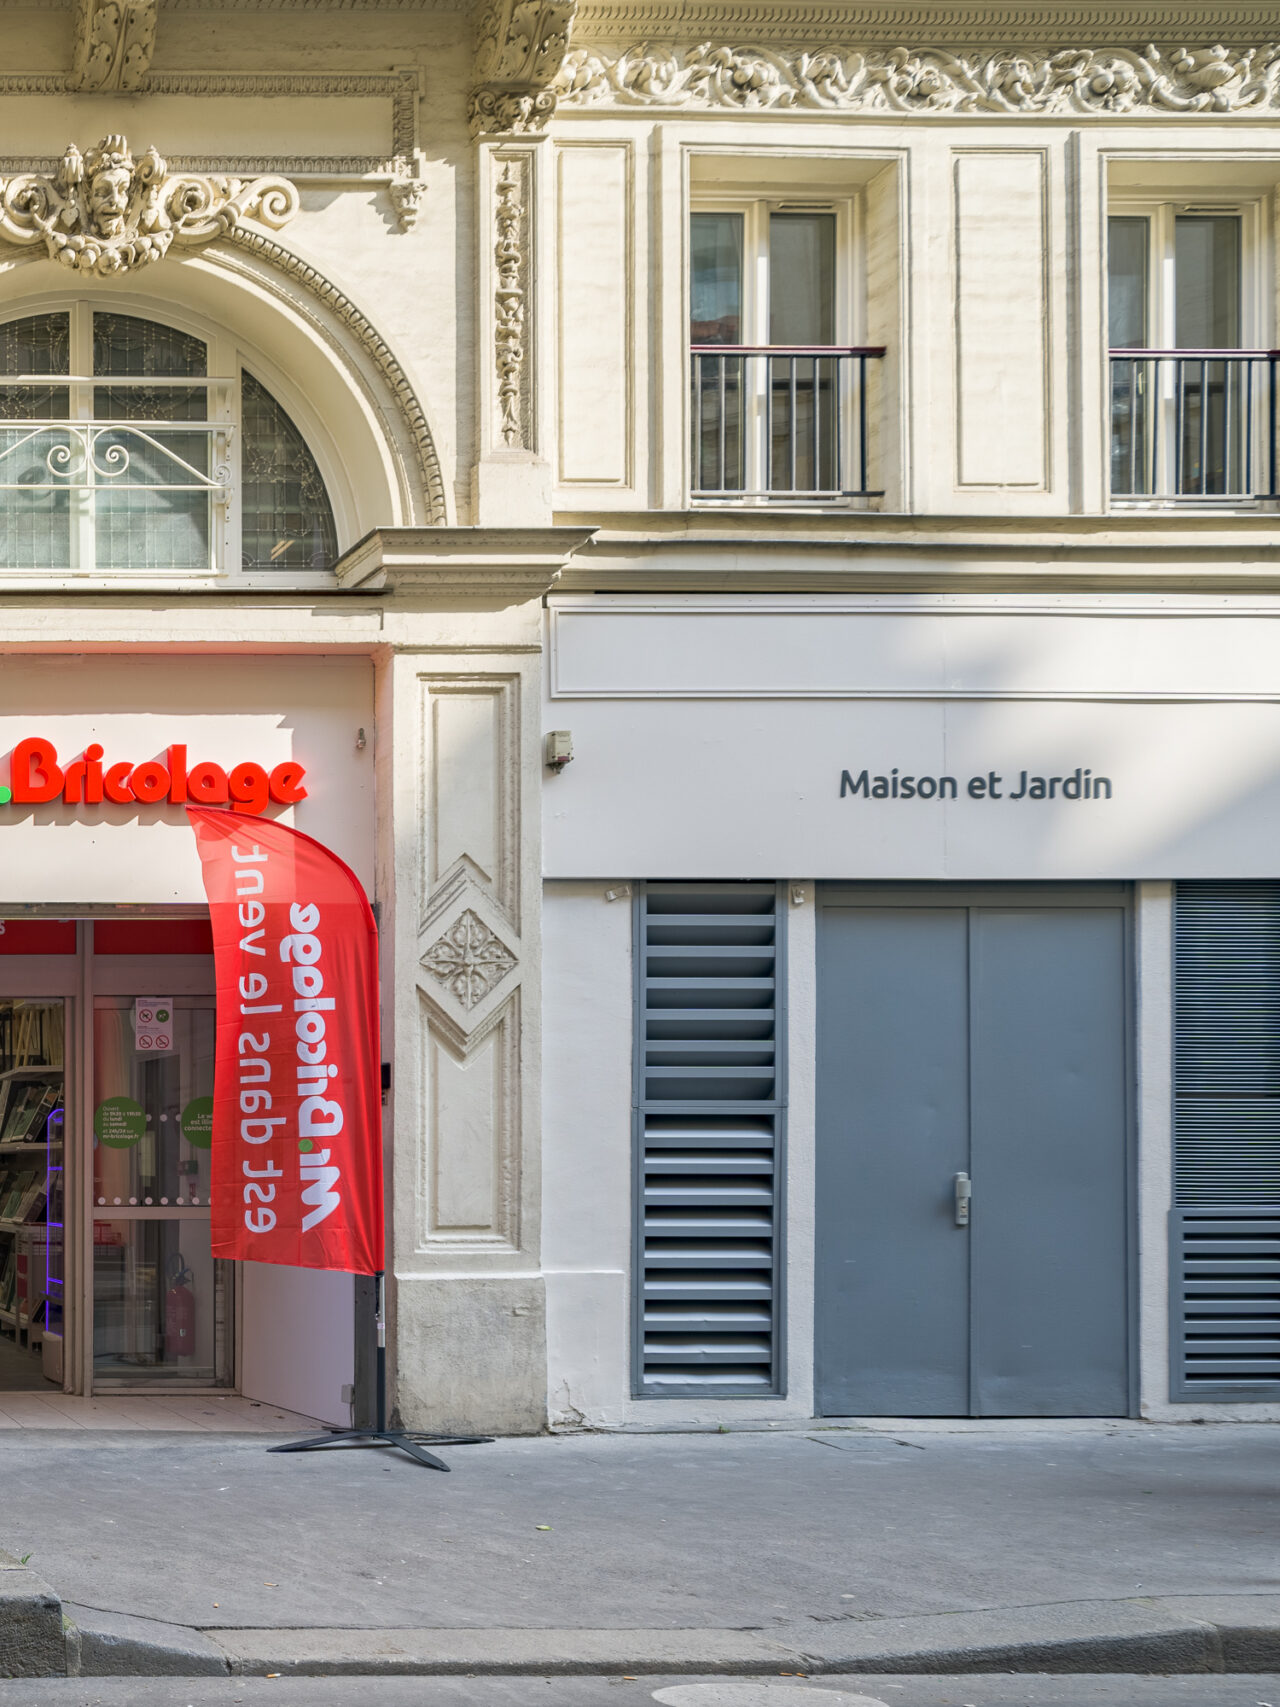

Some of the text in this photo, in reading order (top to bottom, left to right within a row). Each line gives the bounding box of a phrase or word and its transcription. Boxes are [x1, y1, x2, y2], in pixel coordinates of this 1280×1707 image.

[839, 768, 1113, 799] Maison et Jardin
